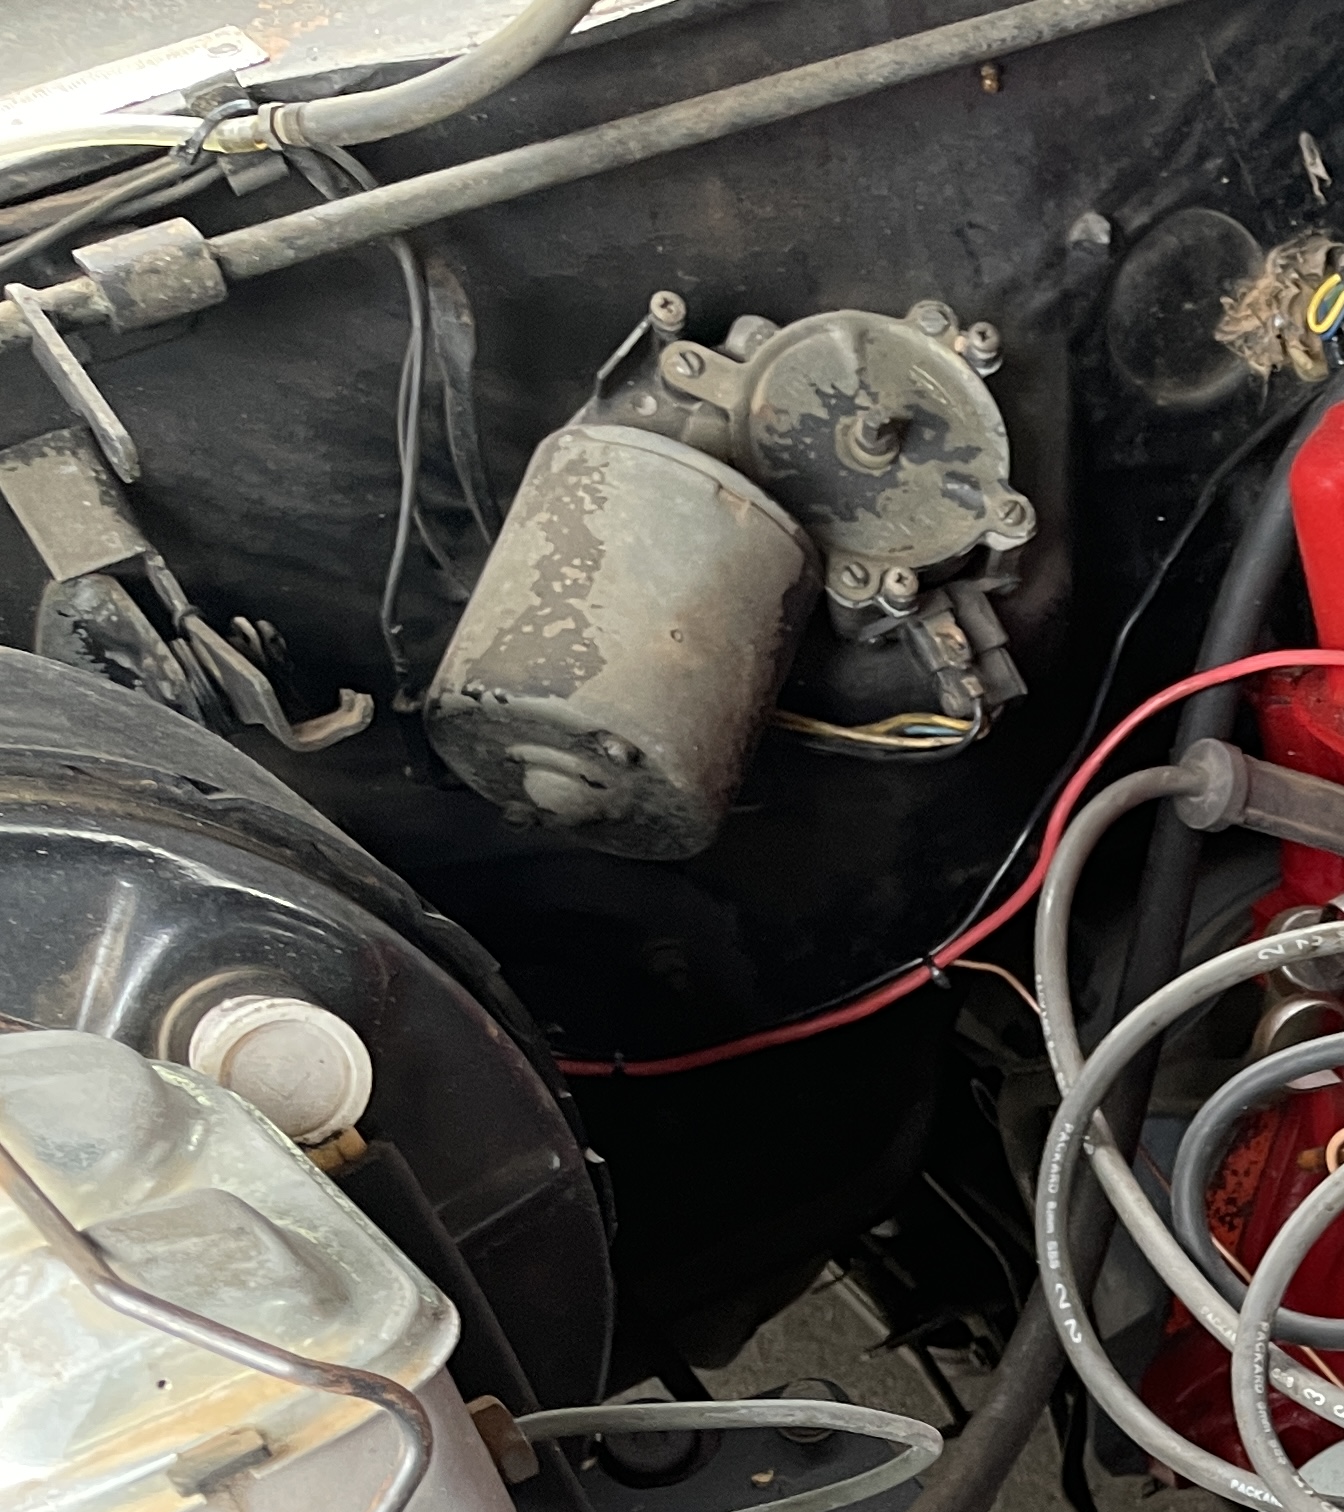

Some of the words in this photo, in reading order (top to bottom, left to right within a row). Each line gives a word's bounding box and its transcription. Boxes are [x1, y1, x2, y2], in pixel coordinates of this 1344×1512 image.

[1046, 1122, 1075, 1194] PACKARD
[1055, 1282, 1072, 1309] 2
[1063, 1318, 1083, 1344] 2
[1253, 1321, 1271, 1395] PACKARD
[1303, 1387, 1326, 1407] 3
